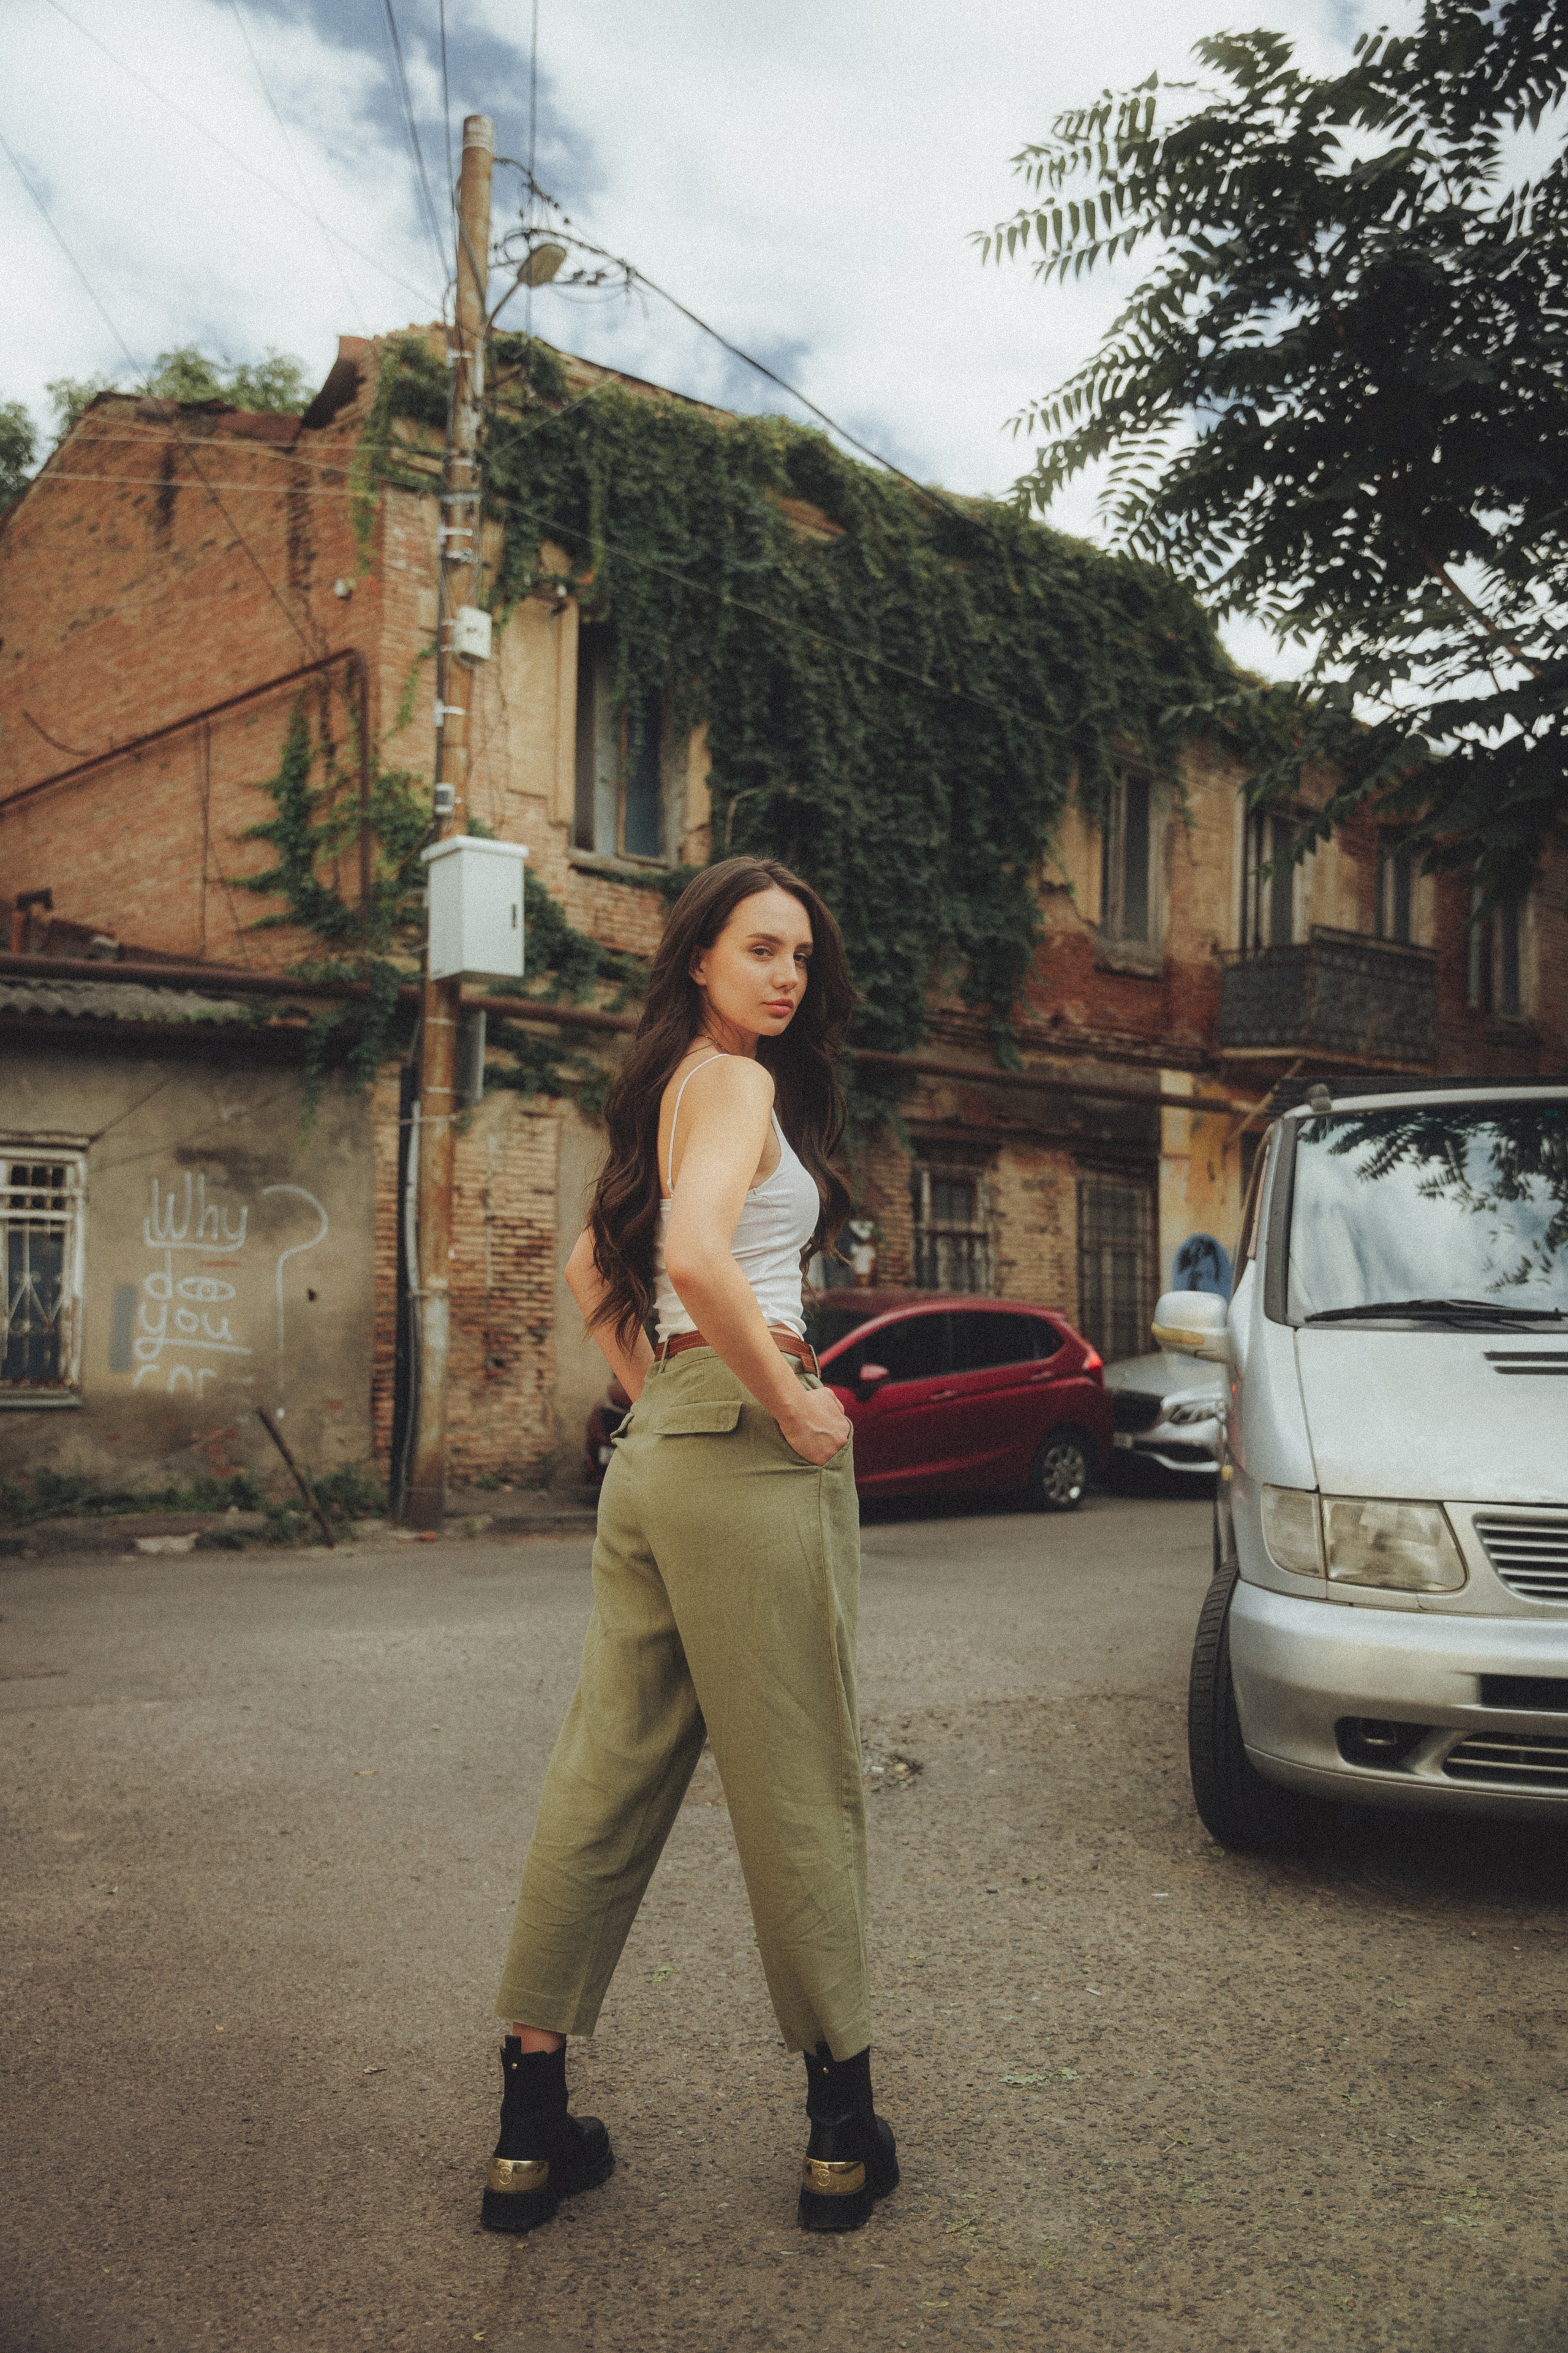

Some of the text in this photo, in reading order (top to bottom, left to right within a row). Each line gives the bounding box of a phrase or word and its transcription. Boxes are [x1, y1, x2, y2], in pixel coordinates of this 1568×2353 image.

[144, 1171, 249, 1253] Why
[143, 1249, 237, 1302] do
[133, 1302, 254, 1361] you
